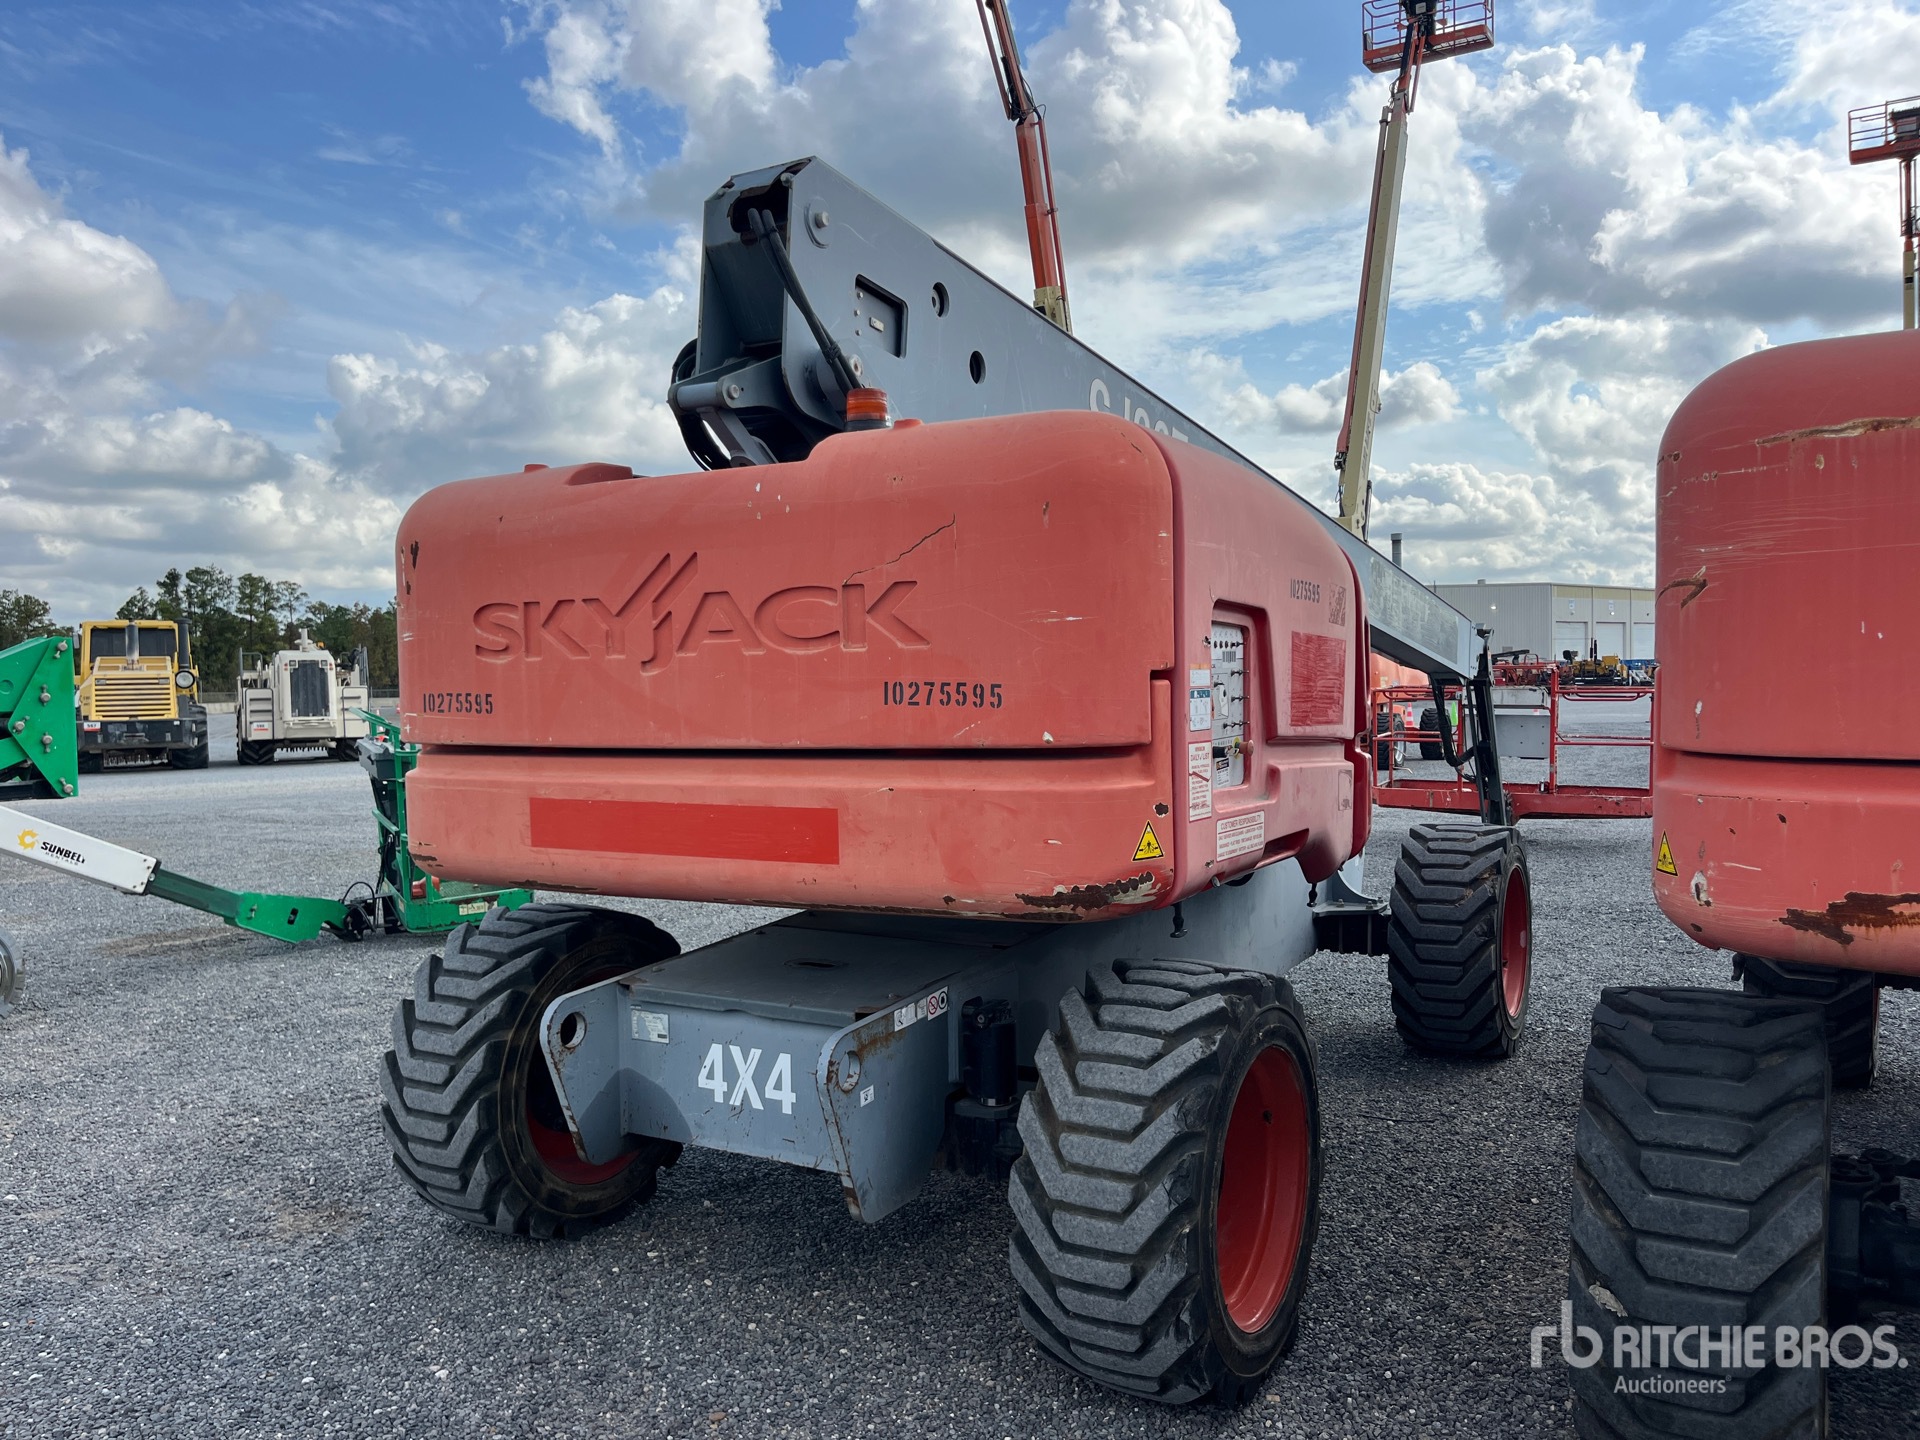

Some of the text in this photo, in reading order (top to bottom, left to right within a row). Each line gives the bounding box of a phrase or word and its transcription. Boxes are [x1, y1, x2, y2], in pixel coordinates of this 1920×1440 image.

[1289, 579, 1321, 603] 10275595
[472, 551, 932, 677] SKYJACK
[423, 692, 494, 714] 10275595
[884, 681, 1003, 708] 10275595
[698, 1043, 797, 1115] 4X4
